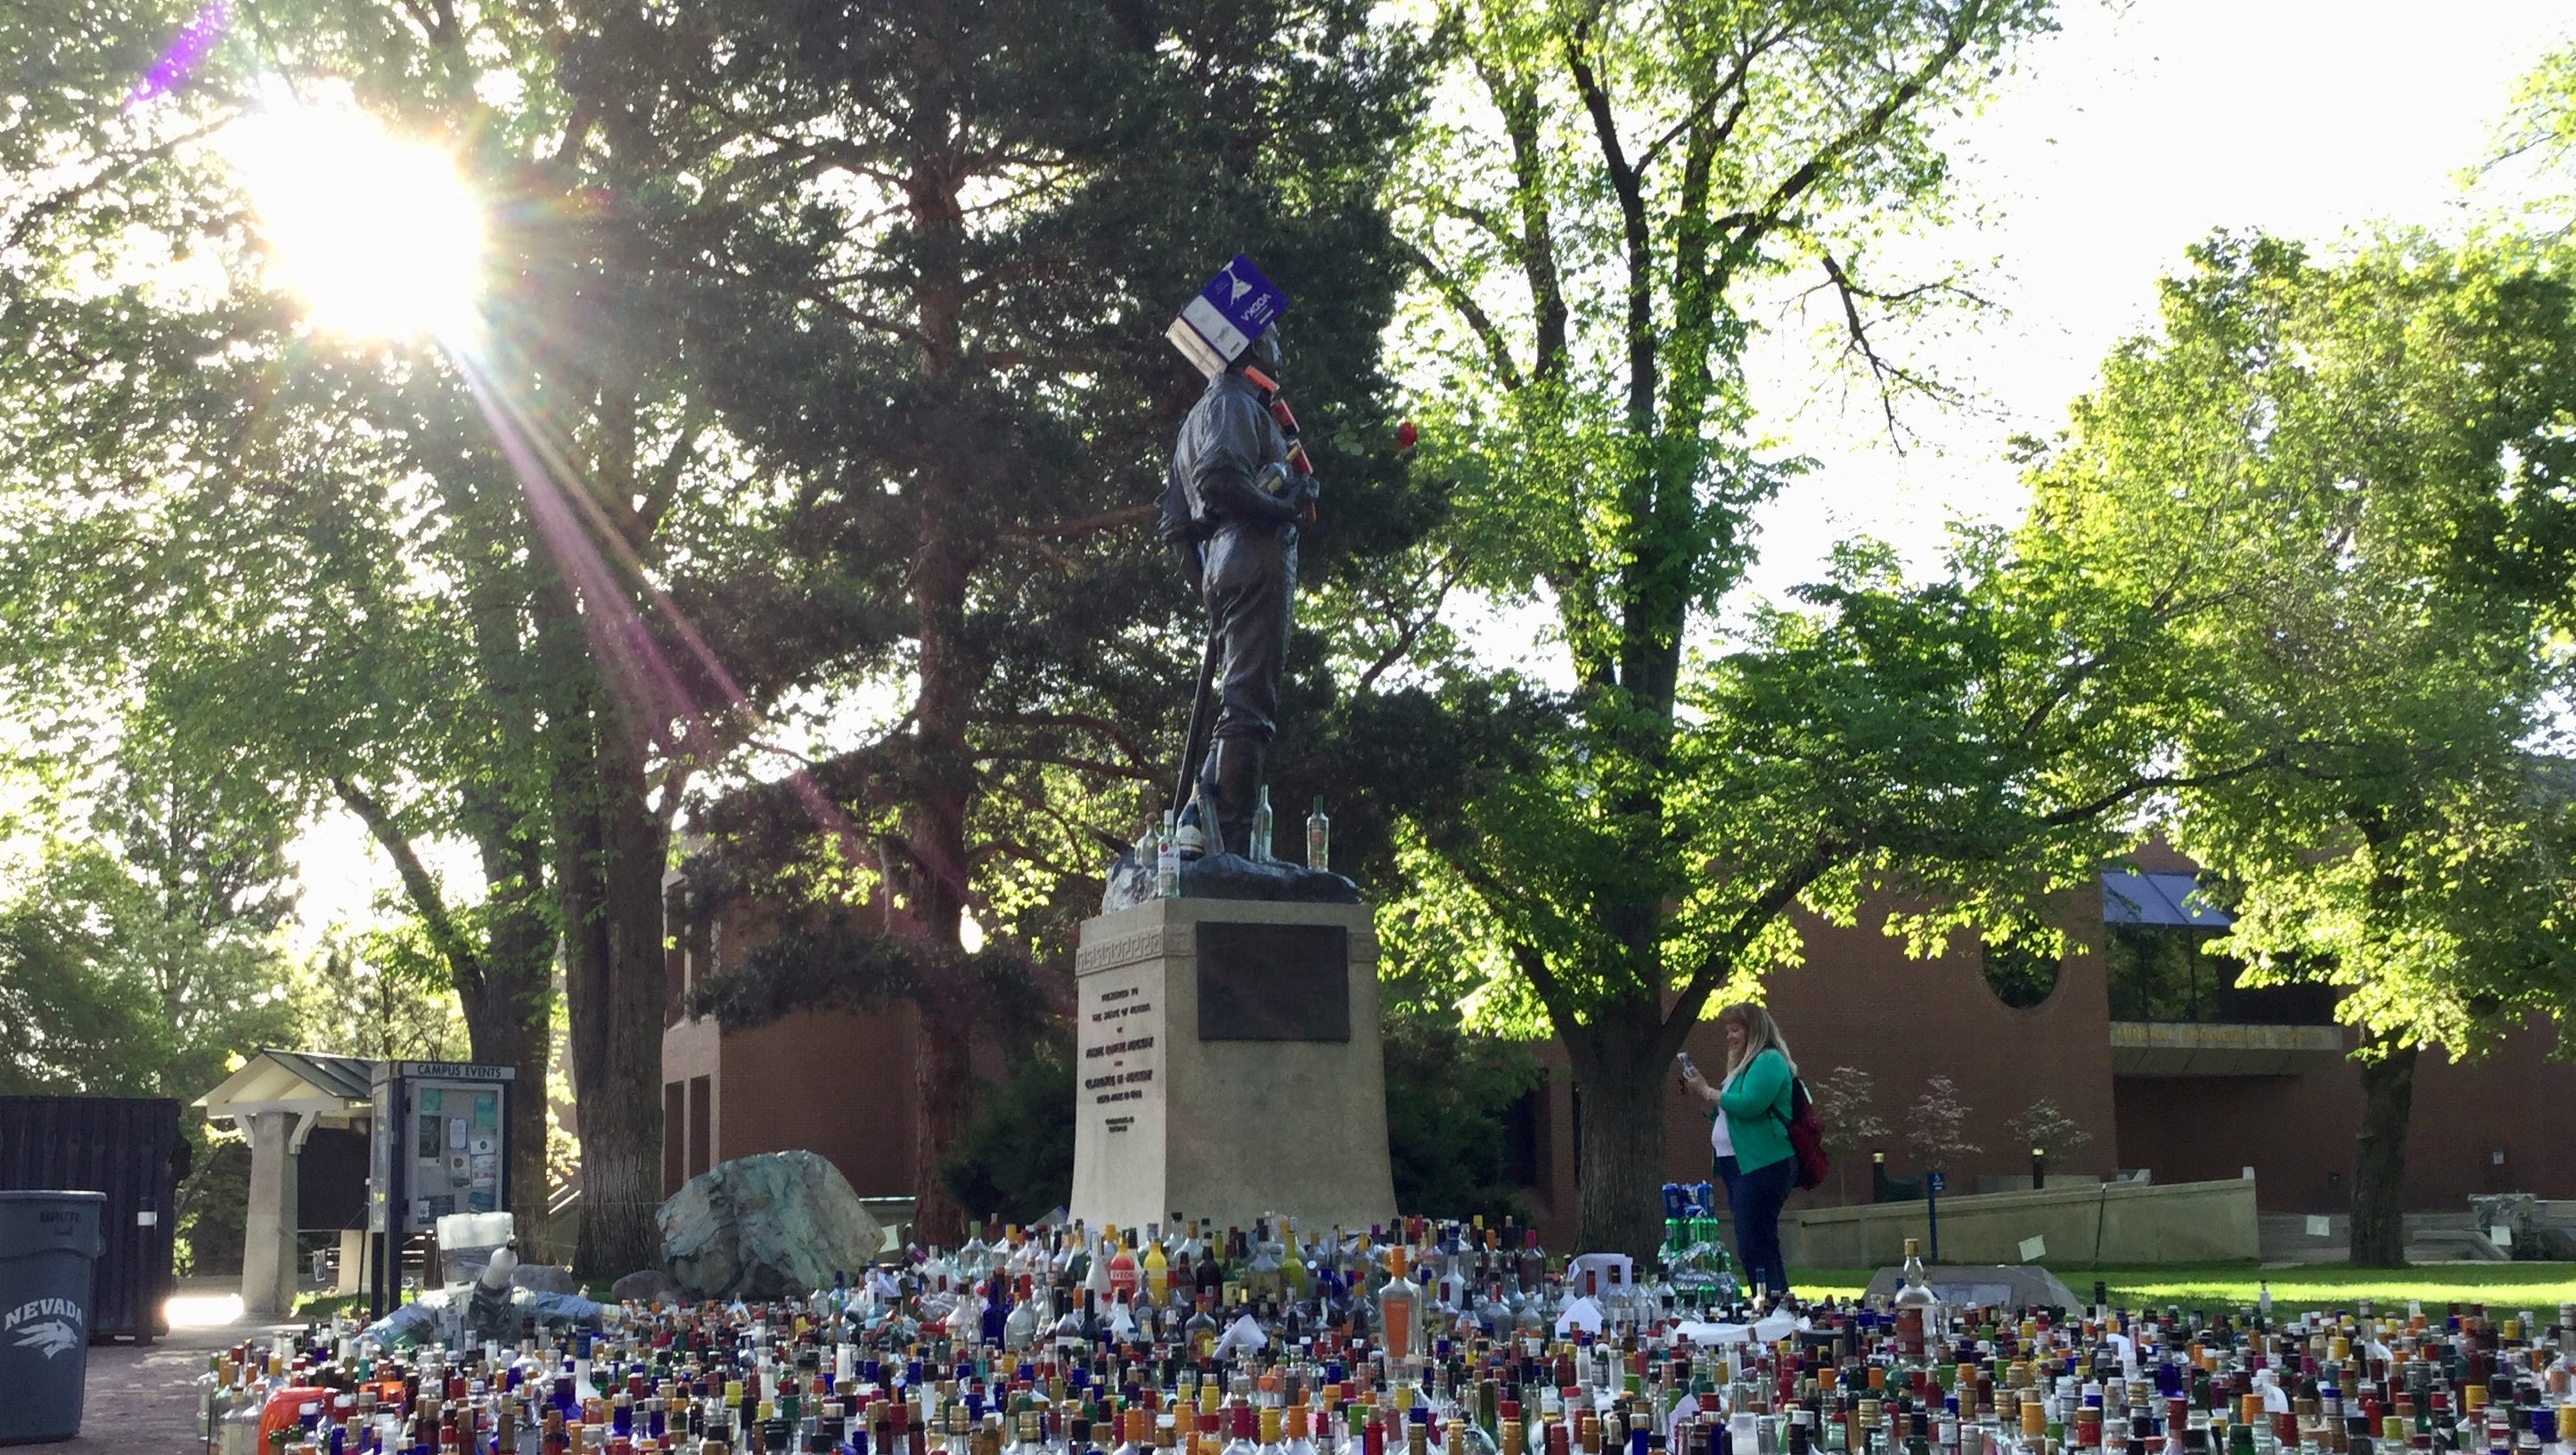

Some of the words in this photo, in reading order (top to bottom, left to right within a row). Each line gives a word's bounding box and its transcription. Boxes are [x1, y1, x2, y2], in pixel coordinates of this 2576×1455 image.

[1240, 293, 1272, 321] VODKA
[417, 1064, 461, 1076] CAMPUS
[464, 1066, 501, 1078] EVENTS
[4, 1297, 83, 1331] NEVADA
